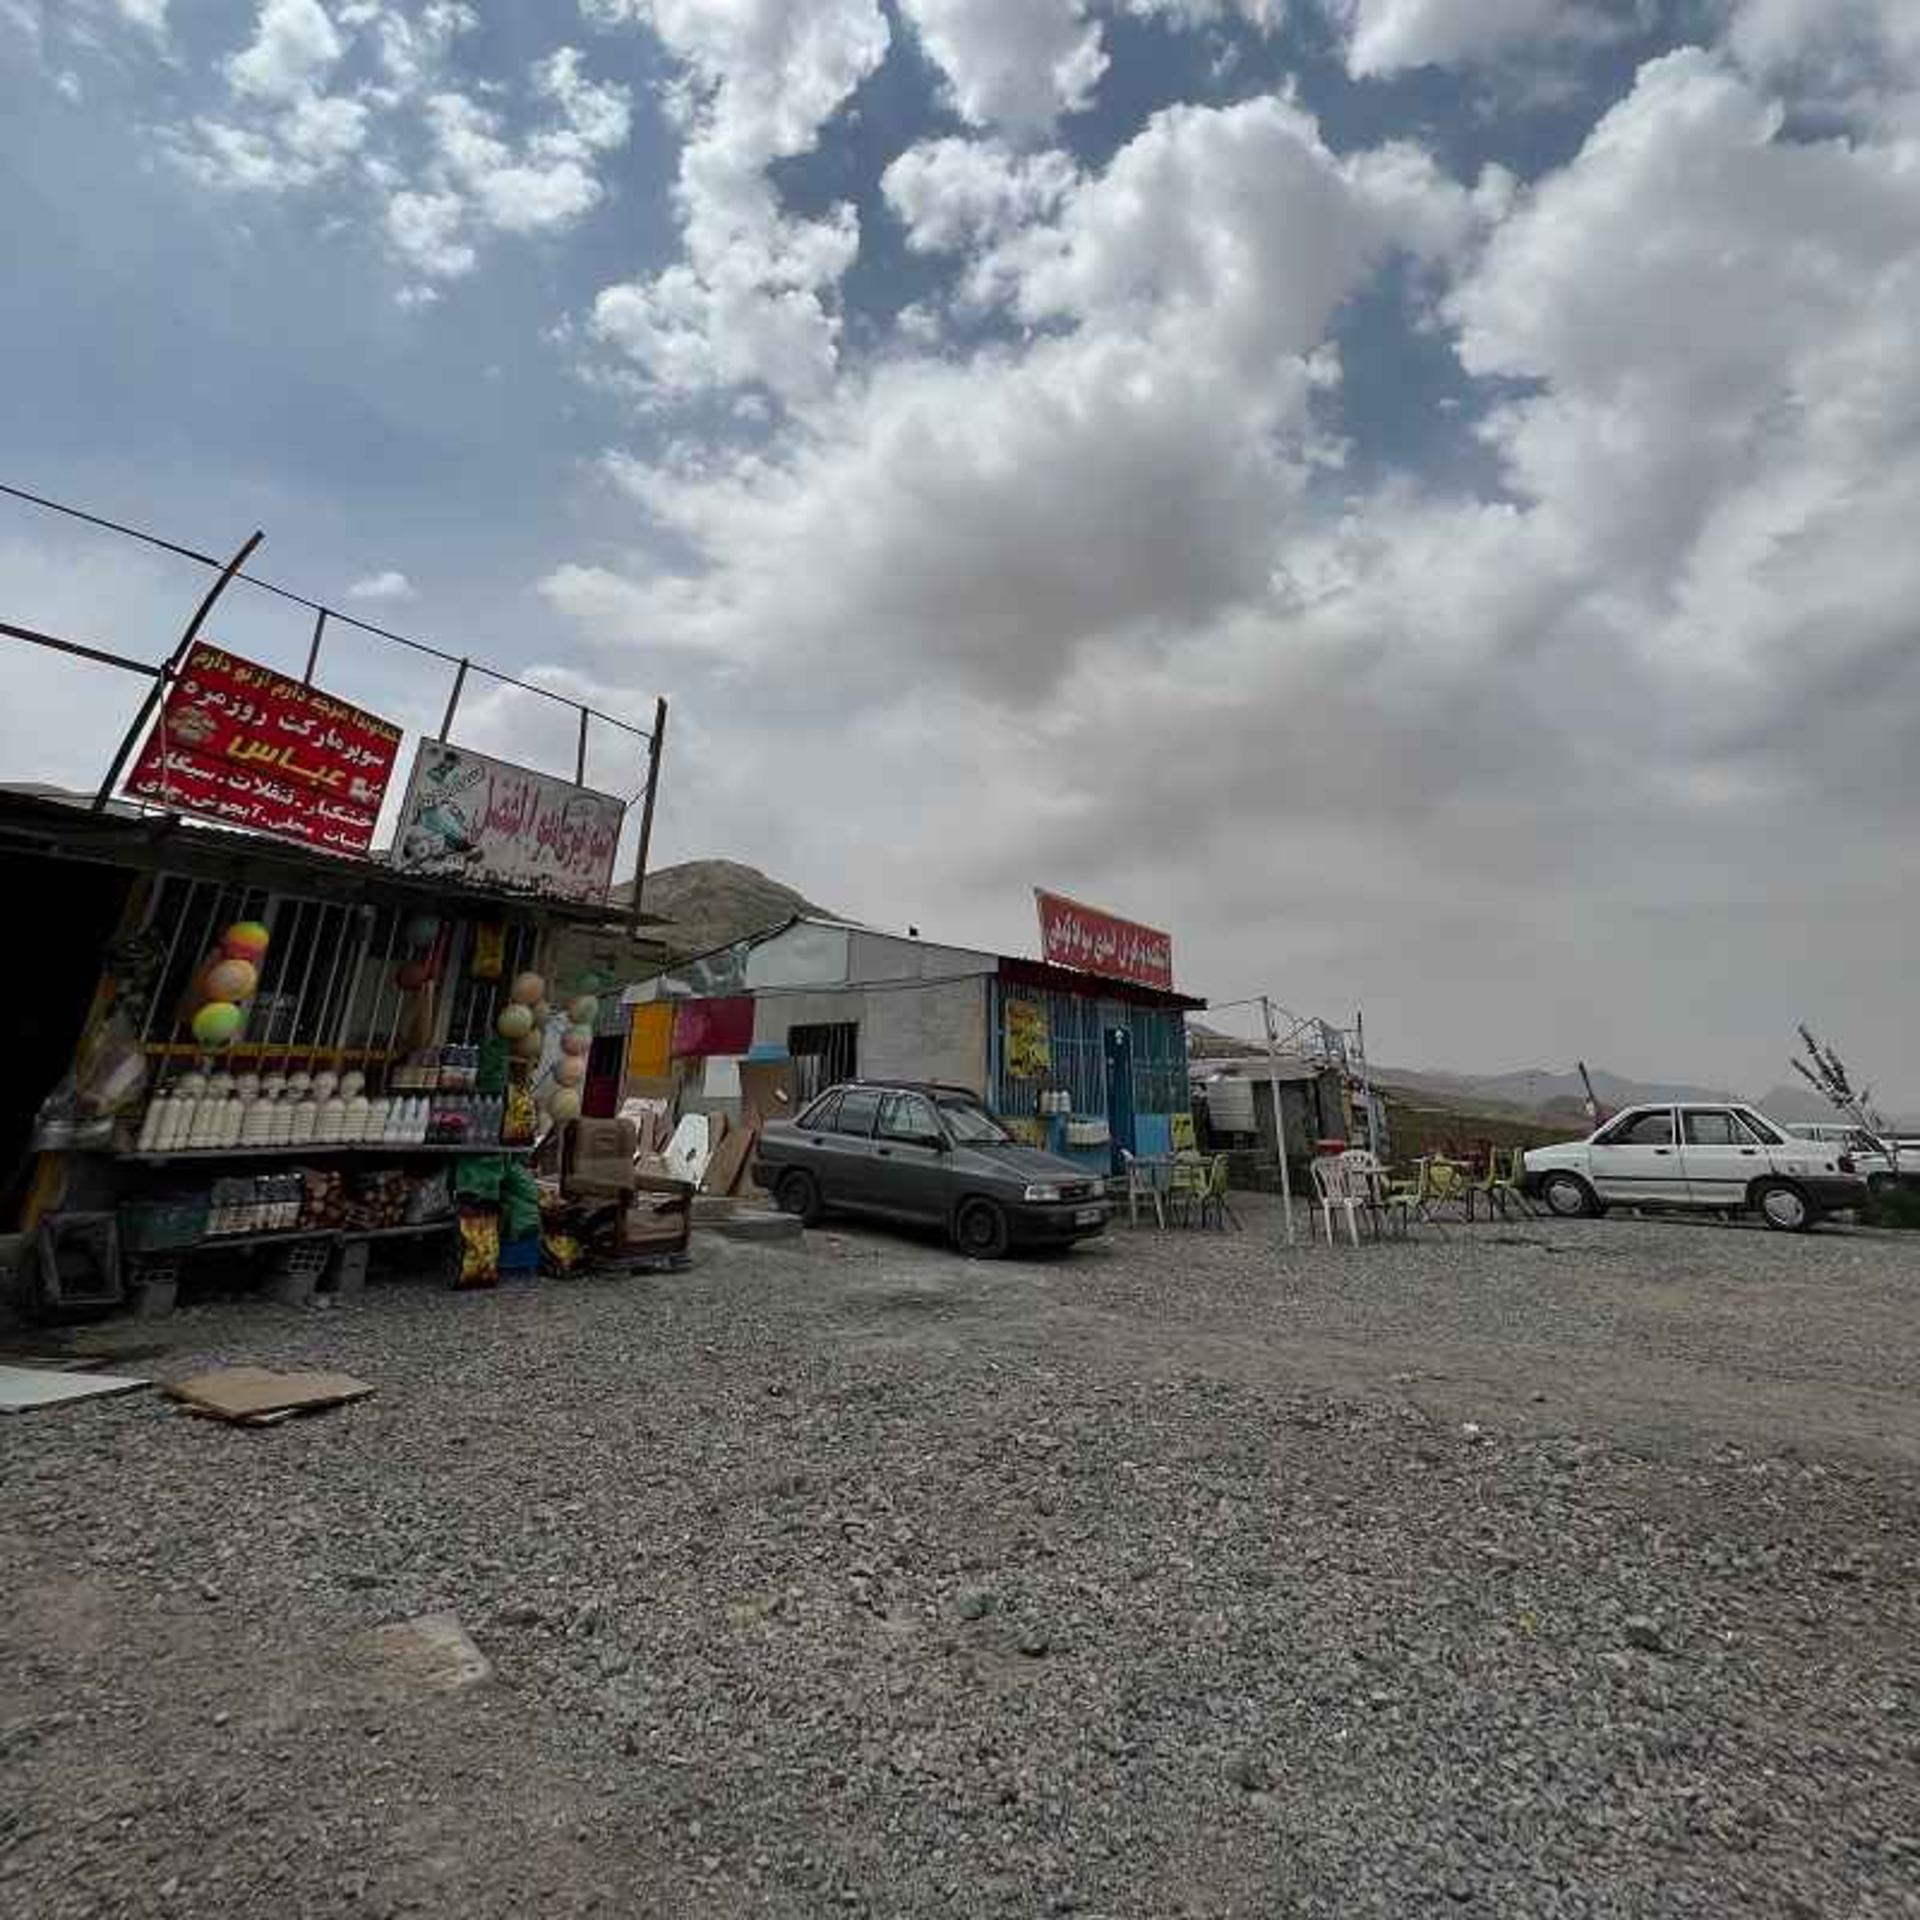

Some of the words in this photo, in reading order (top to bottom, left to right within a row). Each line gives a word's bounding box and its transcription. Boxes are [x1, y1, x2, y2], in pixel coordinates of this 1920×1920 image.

[191, 652, 231, 671] دارم
[270, 682, 308, 702] دارم
[148, 751, 217, 783] سیگار
[226, 736, 347, 787] عباس
[227, 776, 295, 805] تنقلات
[303, 801, 373, 828] خشکبار
[322, 830, 369, 851] لبنیات
